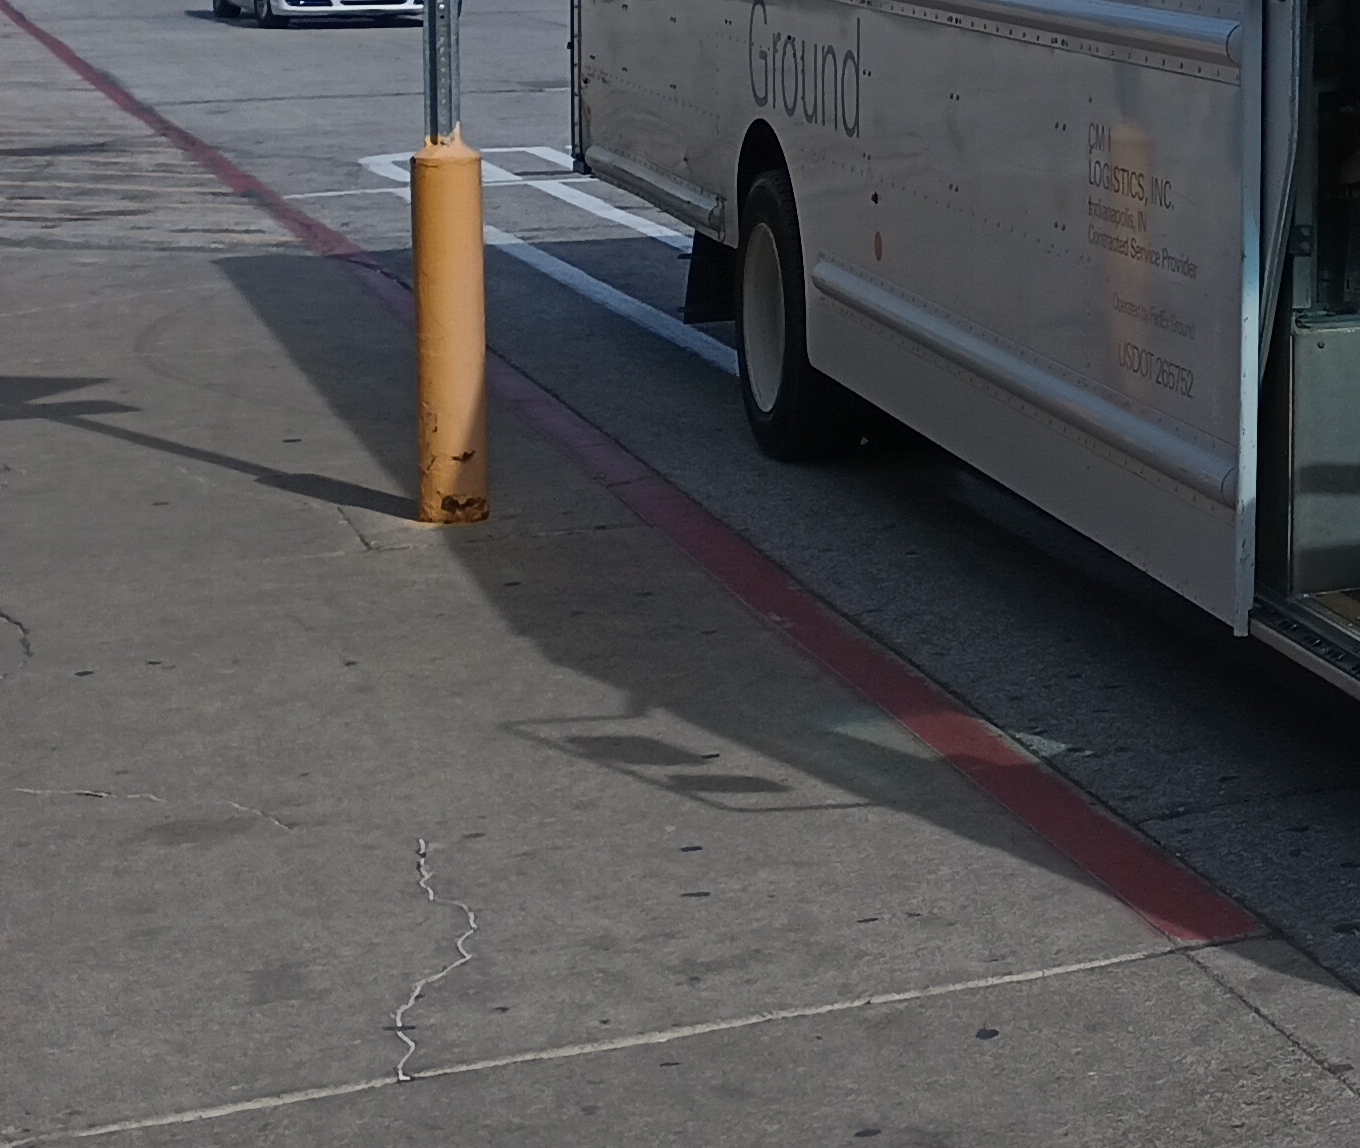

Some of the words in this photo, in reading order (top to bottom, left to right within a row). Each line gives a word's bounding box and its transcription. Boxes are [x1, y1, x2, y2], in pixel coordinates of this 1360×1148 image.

[1088, 156, 1148, 206] LOGISTICS,
[1151, 176, 1175, 209] INC.
[1130, 237, 1160, 267] Service
[1162, 247, 1198, 279] Provider
[1118, 341, 1154, 381] USDOT
[1155, 357, 1194, 399] 265752
